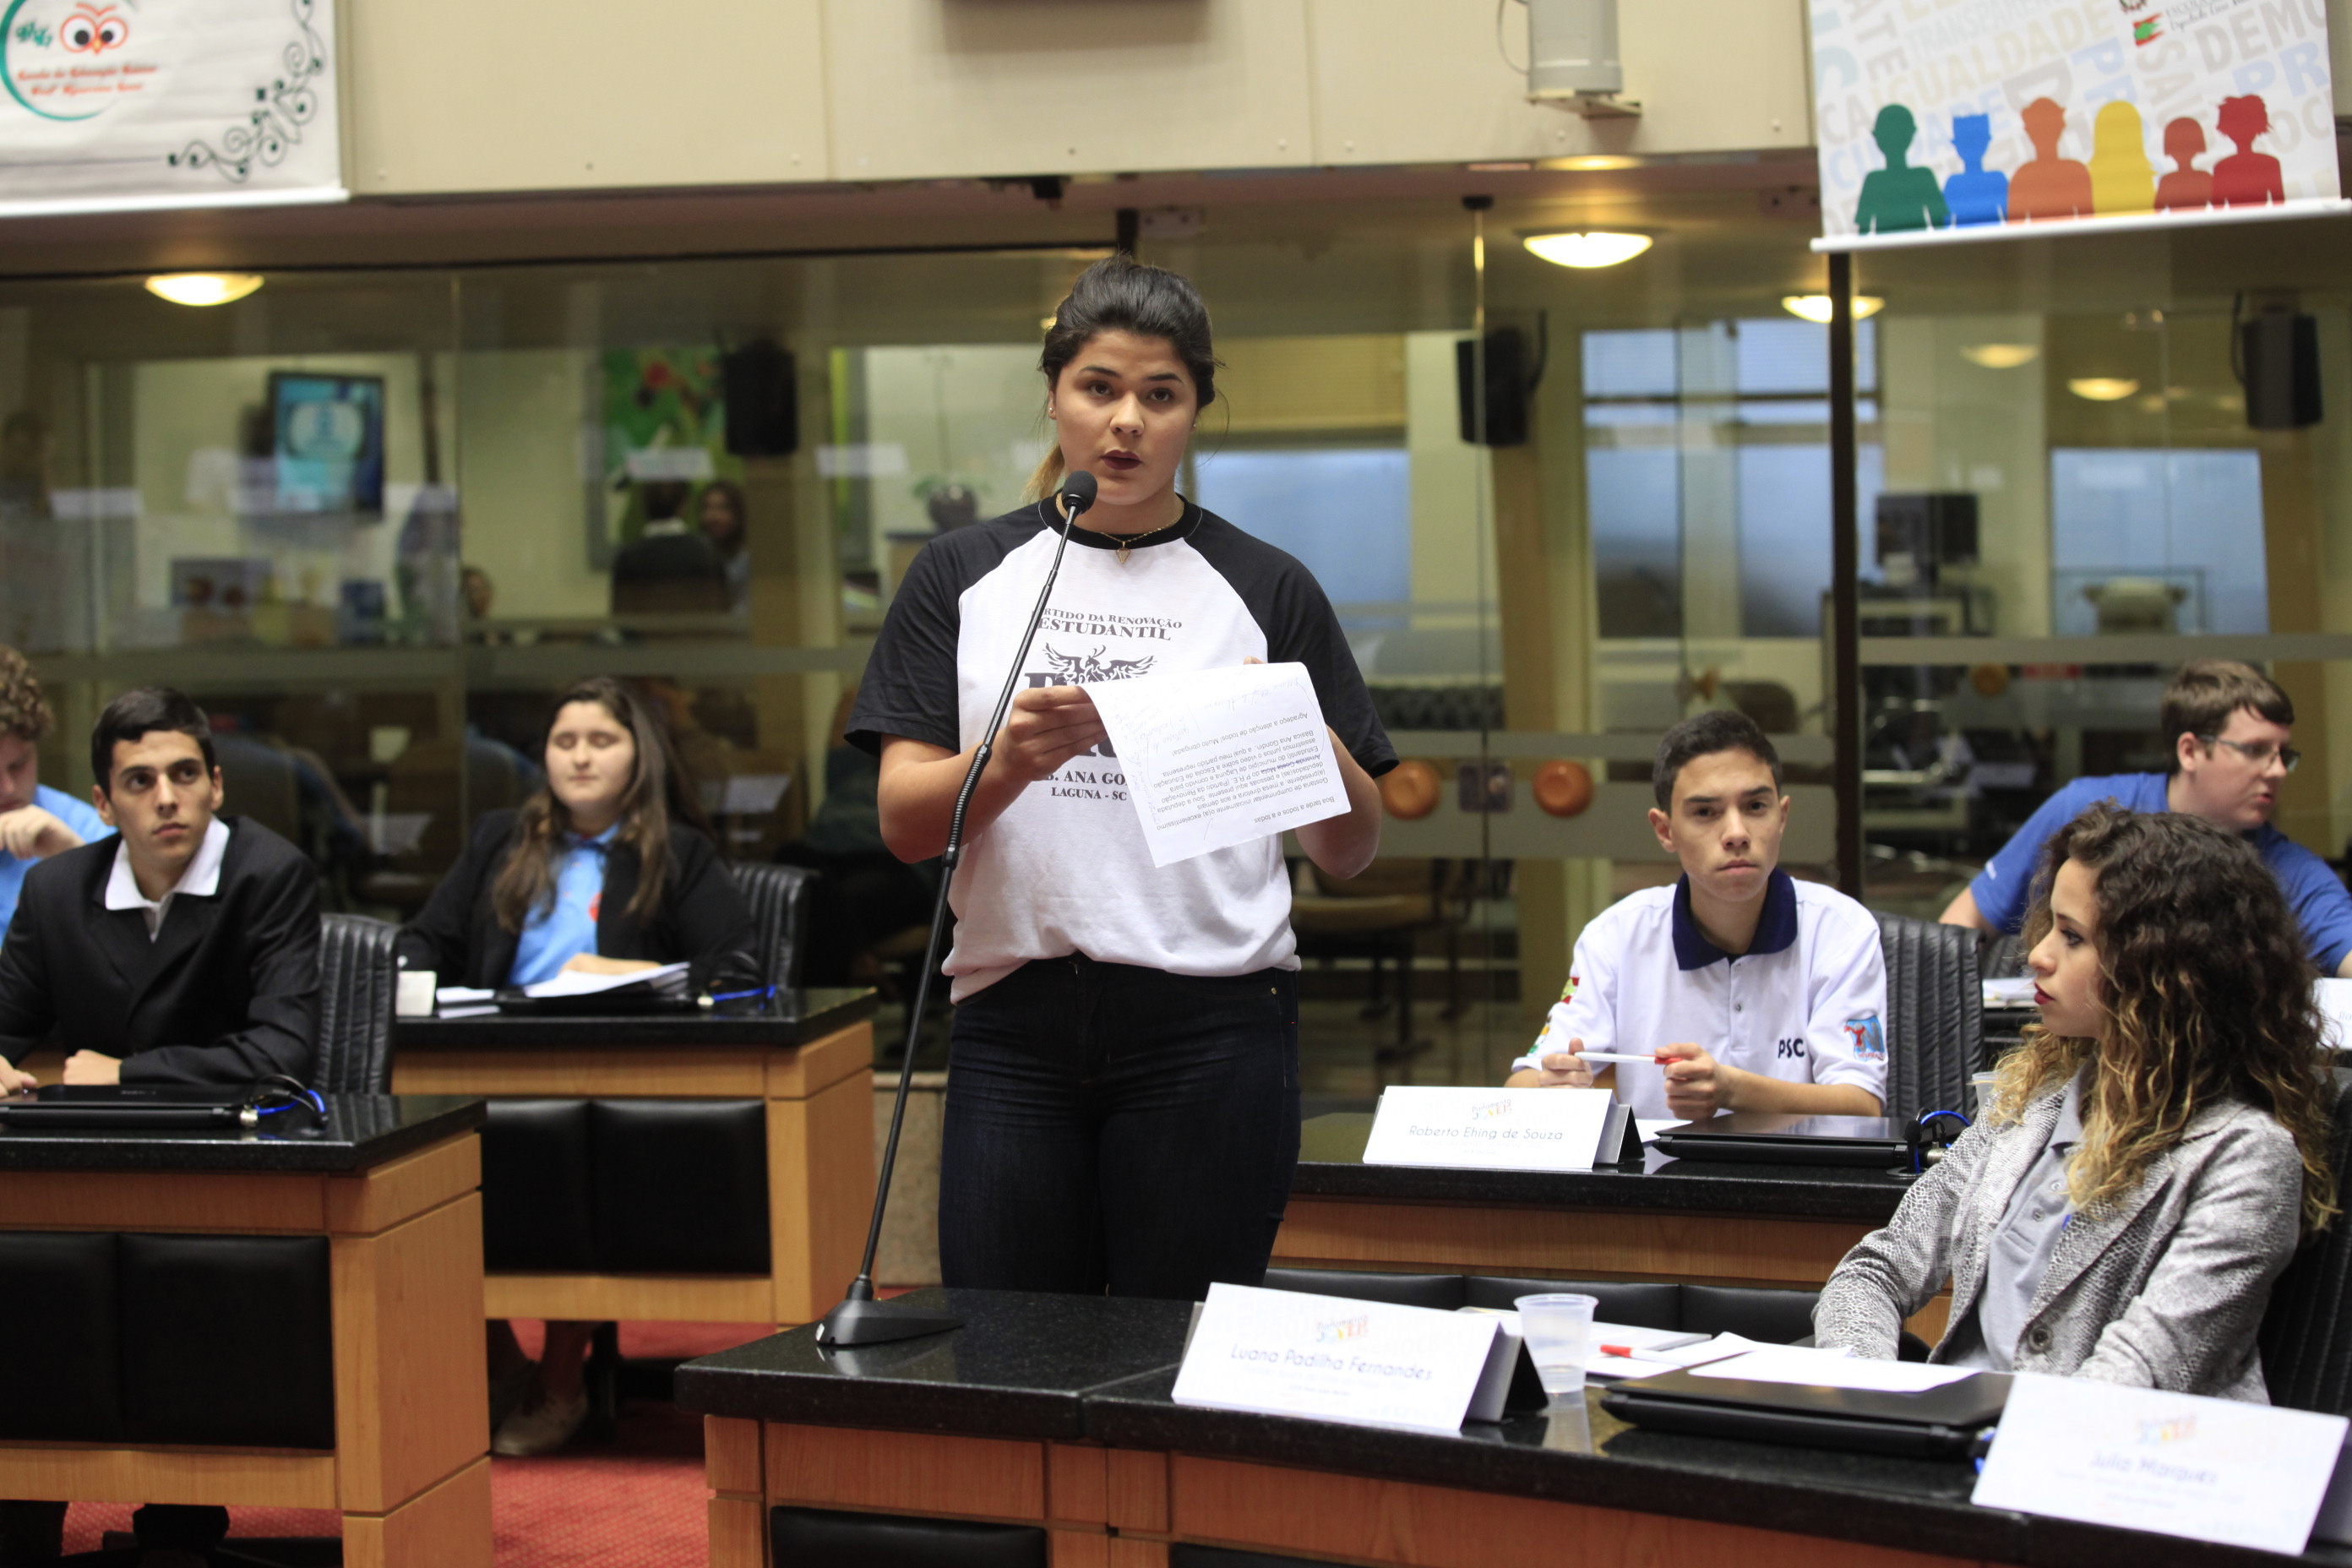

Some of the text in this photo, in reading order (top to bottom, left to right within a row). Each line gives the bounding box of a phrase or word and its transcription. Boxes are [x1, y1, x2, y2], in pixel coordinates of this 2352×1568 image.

[1088, 613, 1104, 623] DA
[1108, 614, 1183, 629] RENOVAÇÃO
[1037, 618, 1172, 641] ESTUDANTIL
[1064, 770, 1097, 784] ANA
[1102, 772, 1127, 786] GO
[1051, 787, 1101, 799] LAGUNA
[1112, 790, 1127, 801] SC
[1778, 1038, 1805, 1059] PSC
[1409, 1125, 1563, 1141] Roberto Ehing de Souza
[1231, 1343, 1279, 1364] Luana
[1350, 1356, 1433, 1380] Fernandes
